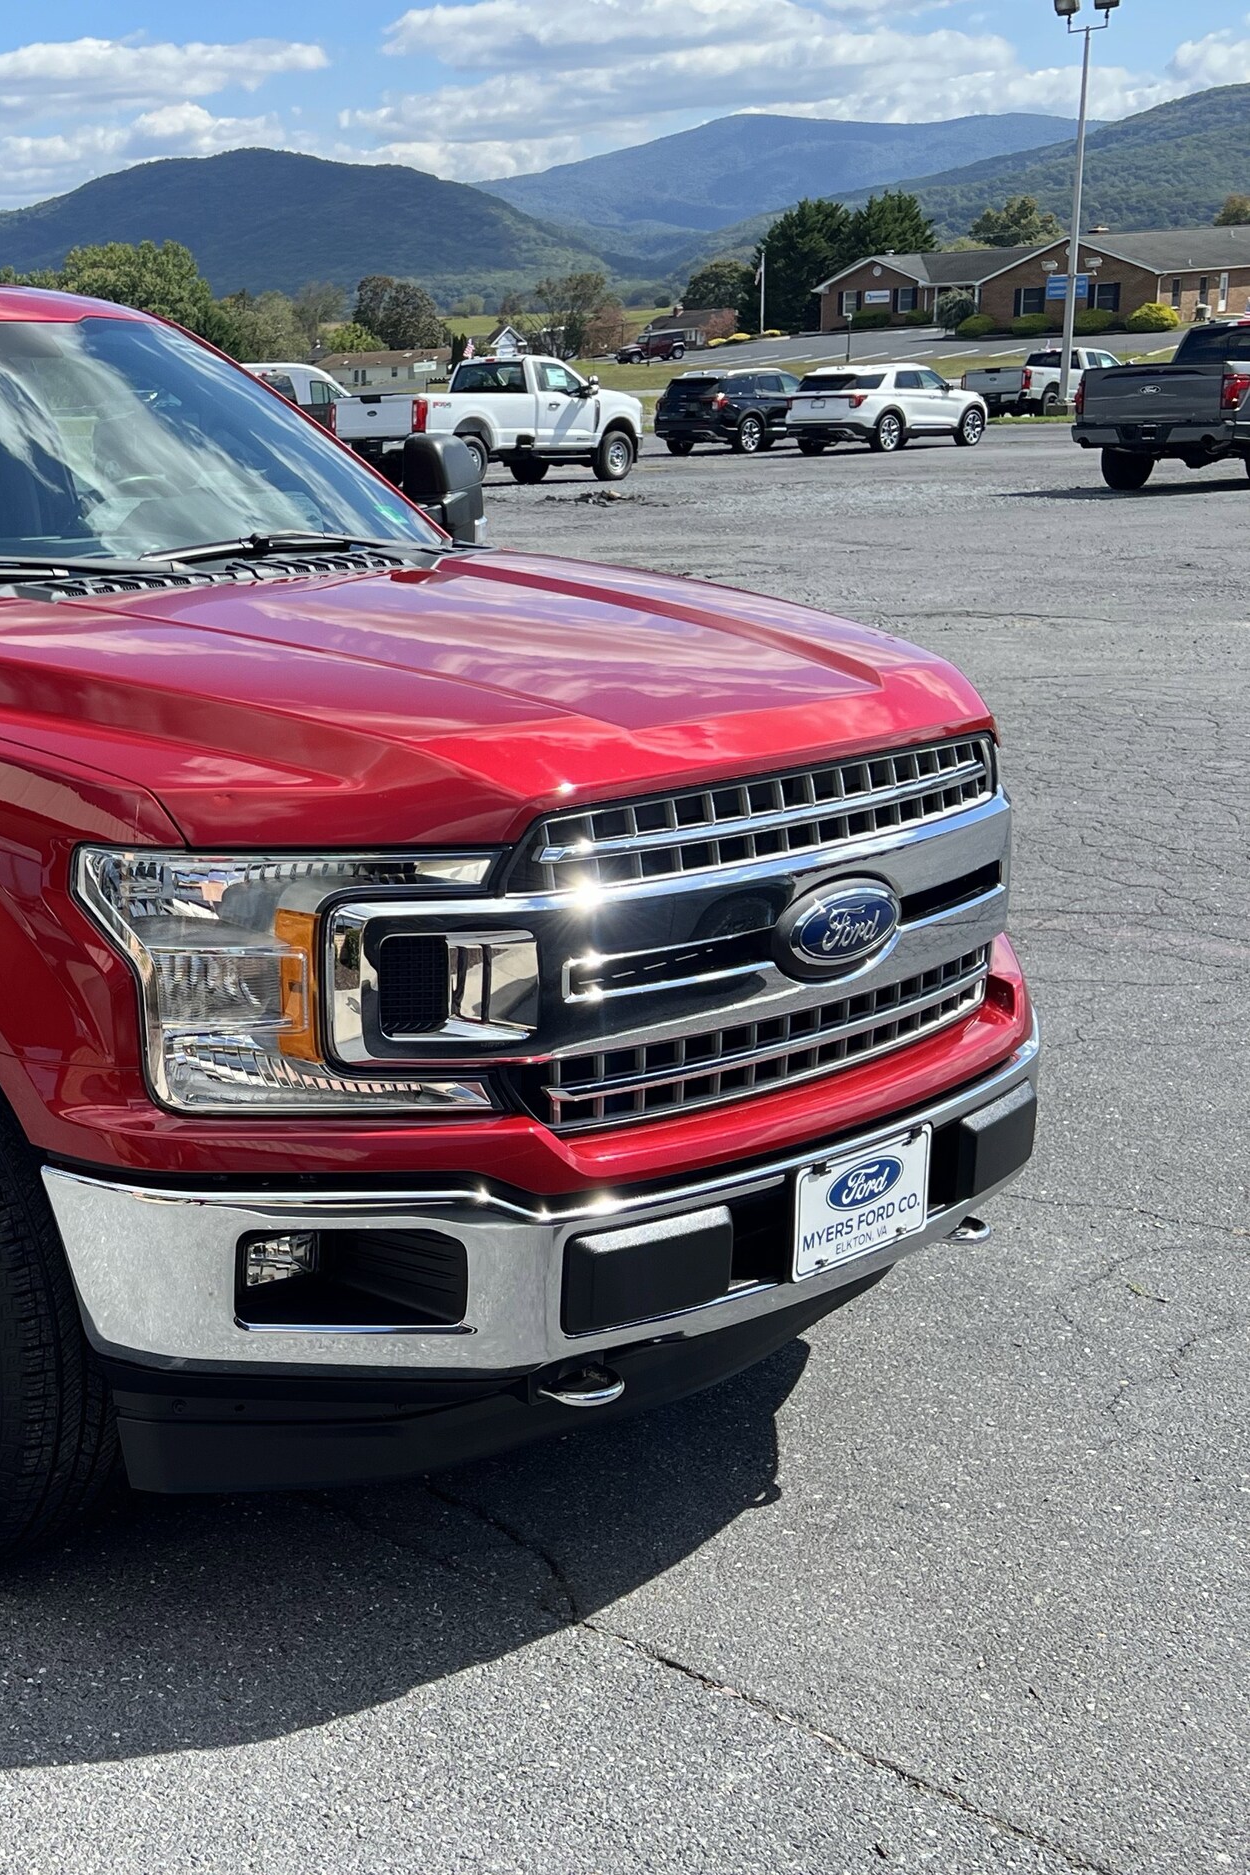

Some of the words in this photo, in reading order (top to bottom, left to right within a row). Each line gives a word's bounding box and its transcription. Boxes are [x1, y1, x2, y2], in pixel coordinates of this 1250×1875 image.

[822, 904, 881, 951] Ford
[841, 1164, 890, 1205] Ford
[802, 1218, 854, 1252] MYERS
[857, 1202, 895, 1231] FORD
[898, 1192, 920, 1213] CO.
[835, 1232, 874, 1255] ELKTON,
[877, 1225, 888, 1238] VA
